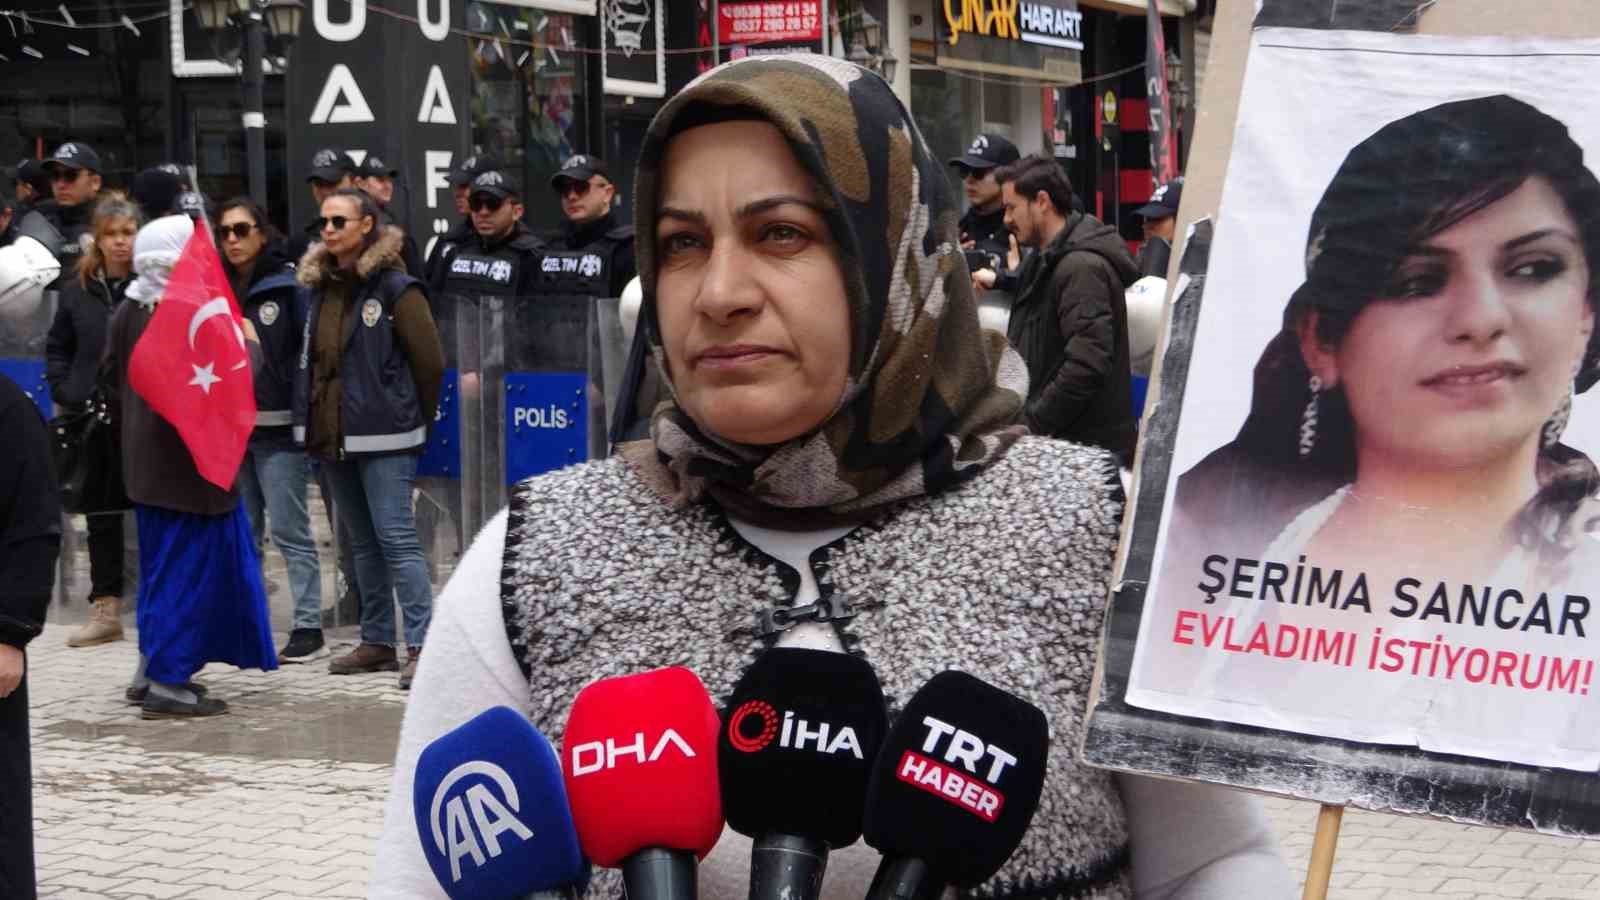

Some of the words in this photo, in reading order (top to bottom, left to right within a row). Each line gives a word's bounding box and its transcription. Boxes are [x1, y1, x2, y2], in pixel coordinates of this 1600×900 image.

[514, 404, 568, 429] POLİS
[1197, 554, 1372, 614] ŞERİMA
[1389, 577, 1591, 638] SANCAR
[1171, 610, 1357, 668] EVLADIMI
[1367, 626, 1593, 696] İSTİYORUM!
[572, 729, 697, 777] DHA
[779, 711, 864, 760] İHA
[922, 716, 1017, 784] TRT
[901, 755, 999, 817] HABER
[446, 783, 534, 883] AA
